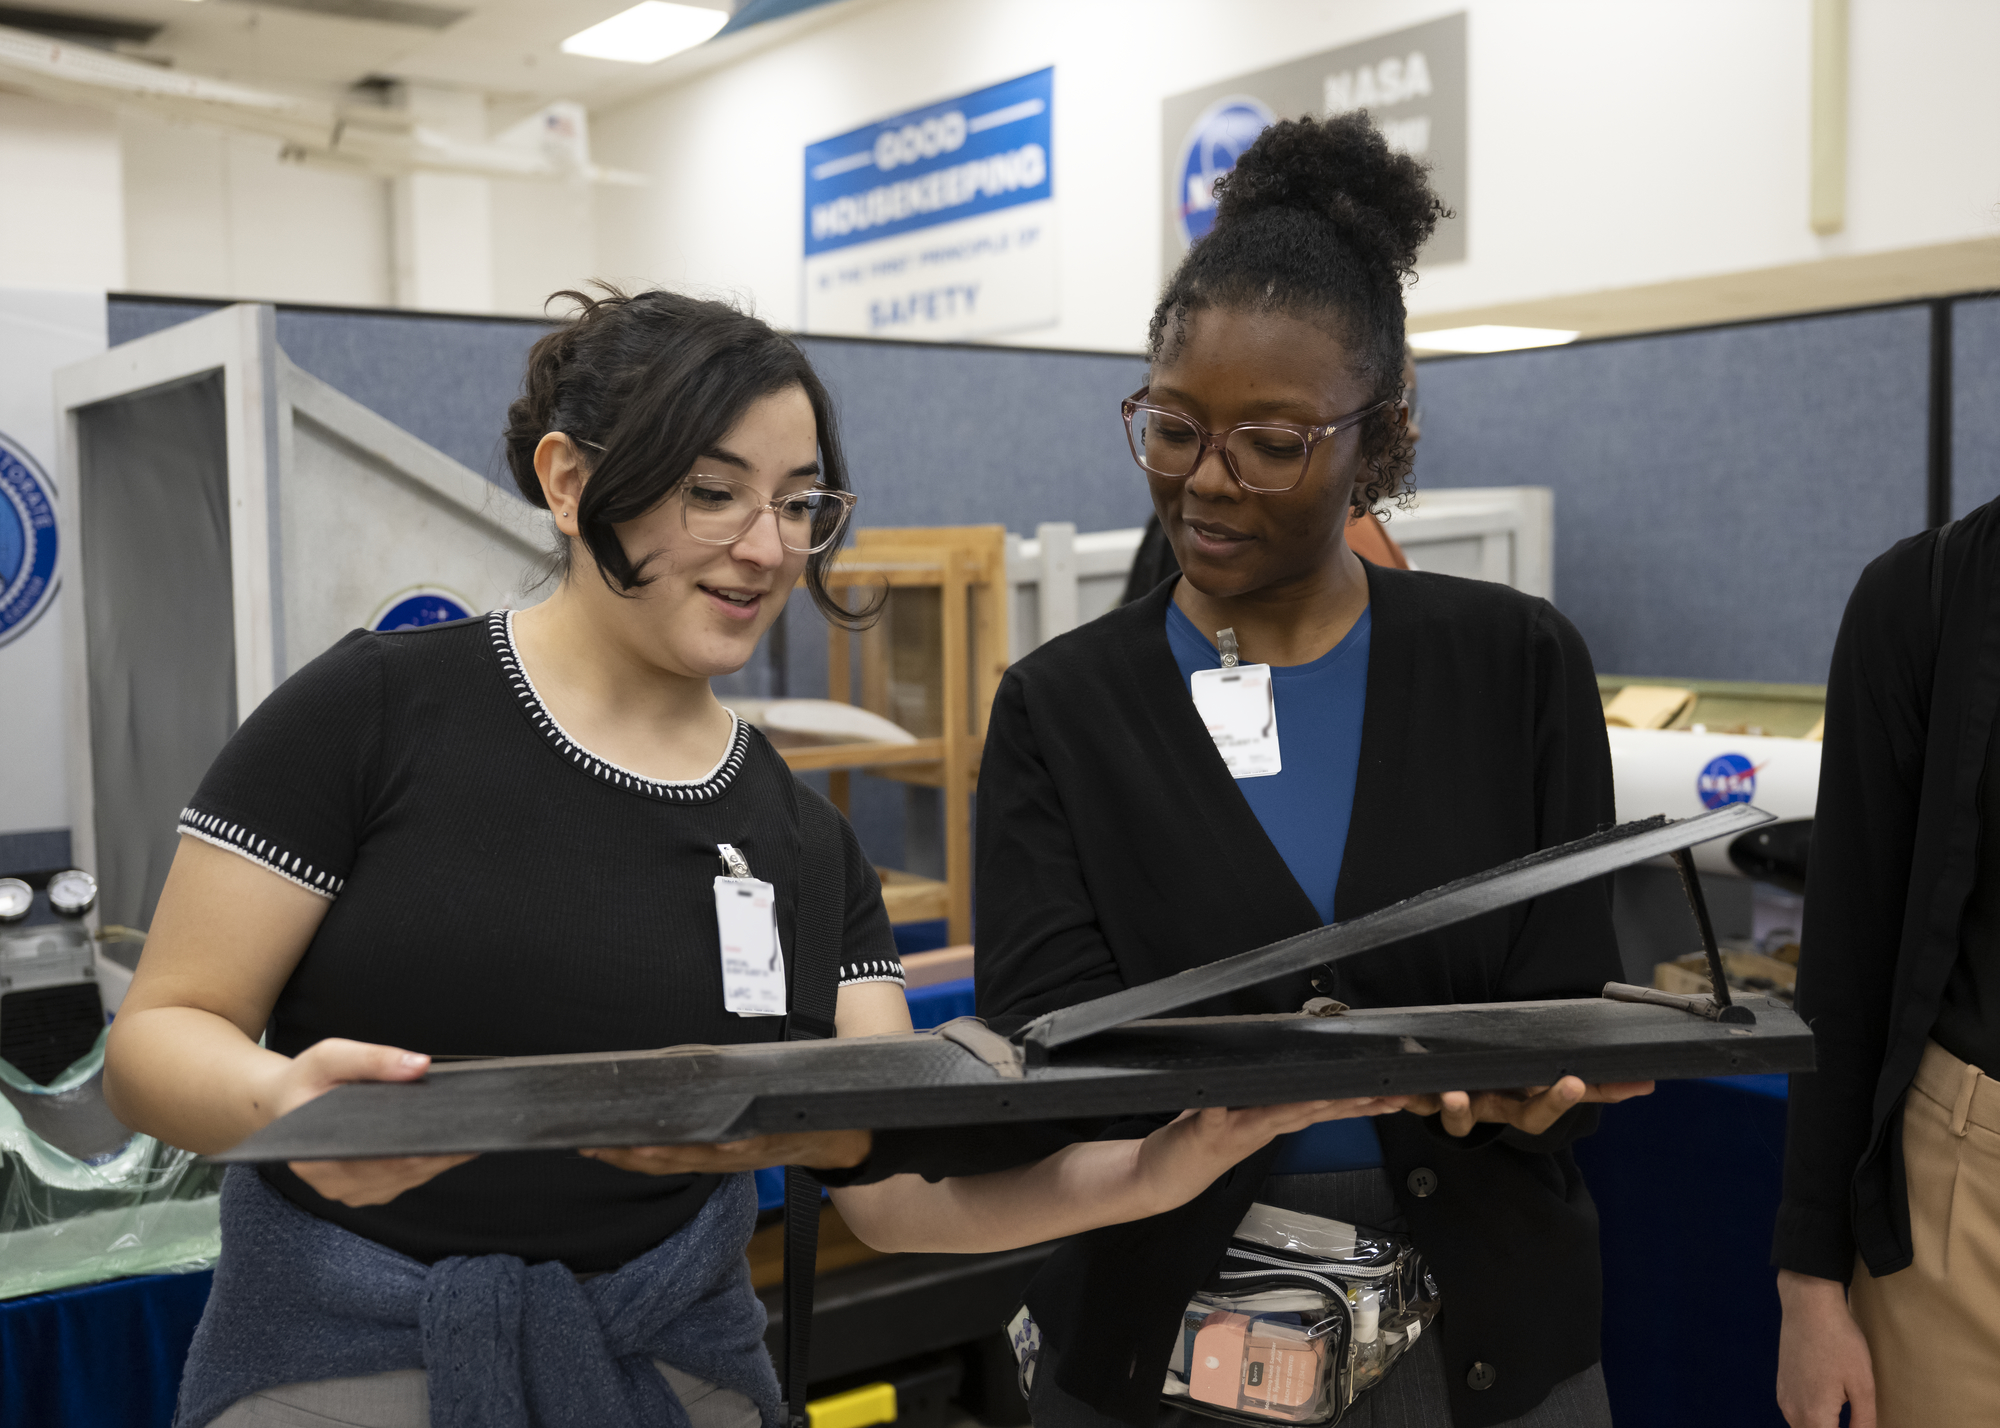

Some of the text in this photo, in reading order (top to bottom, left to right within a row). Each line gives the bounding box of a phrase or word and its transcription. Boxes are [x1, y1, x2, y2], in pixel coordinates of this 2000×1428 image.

[1324, 51, 1433, 115] NASA
[873, 110, 968, 172] GOOD
[811, 142, 1047, 241] HOUSEKEEPING
[869, 282, 979, 330] SAFETY
[0, 451, 53, 530] TORATE
[1701, 773, 1752, 795] NASA
